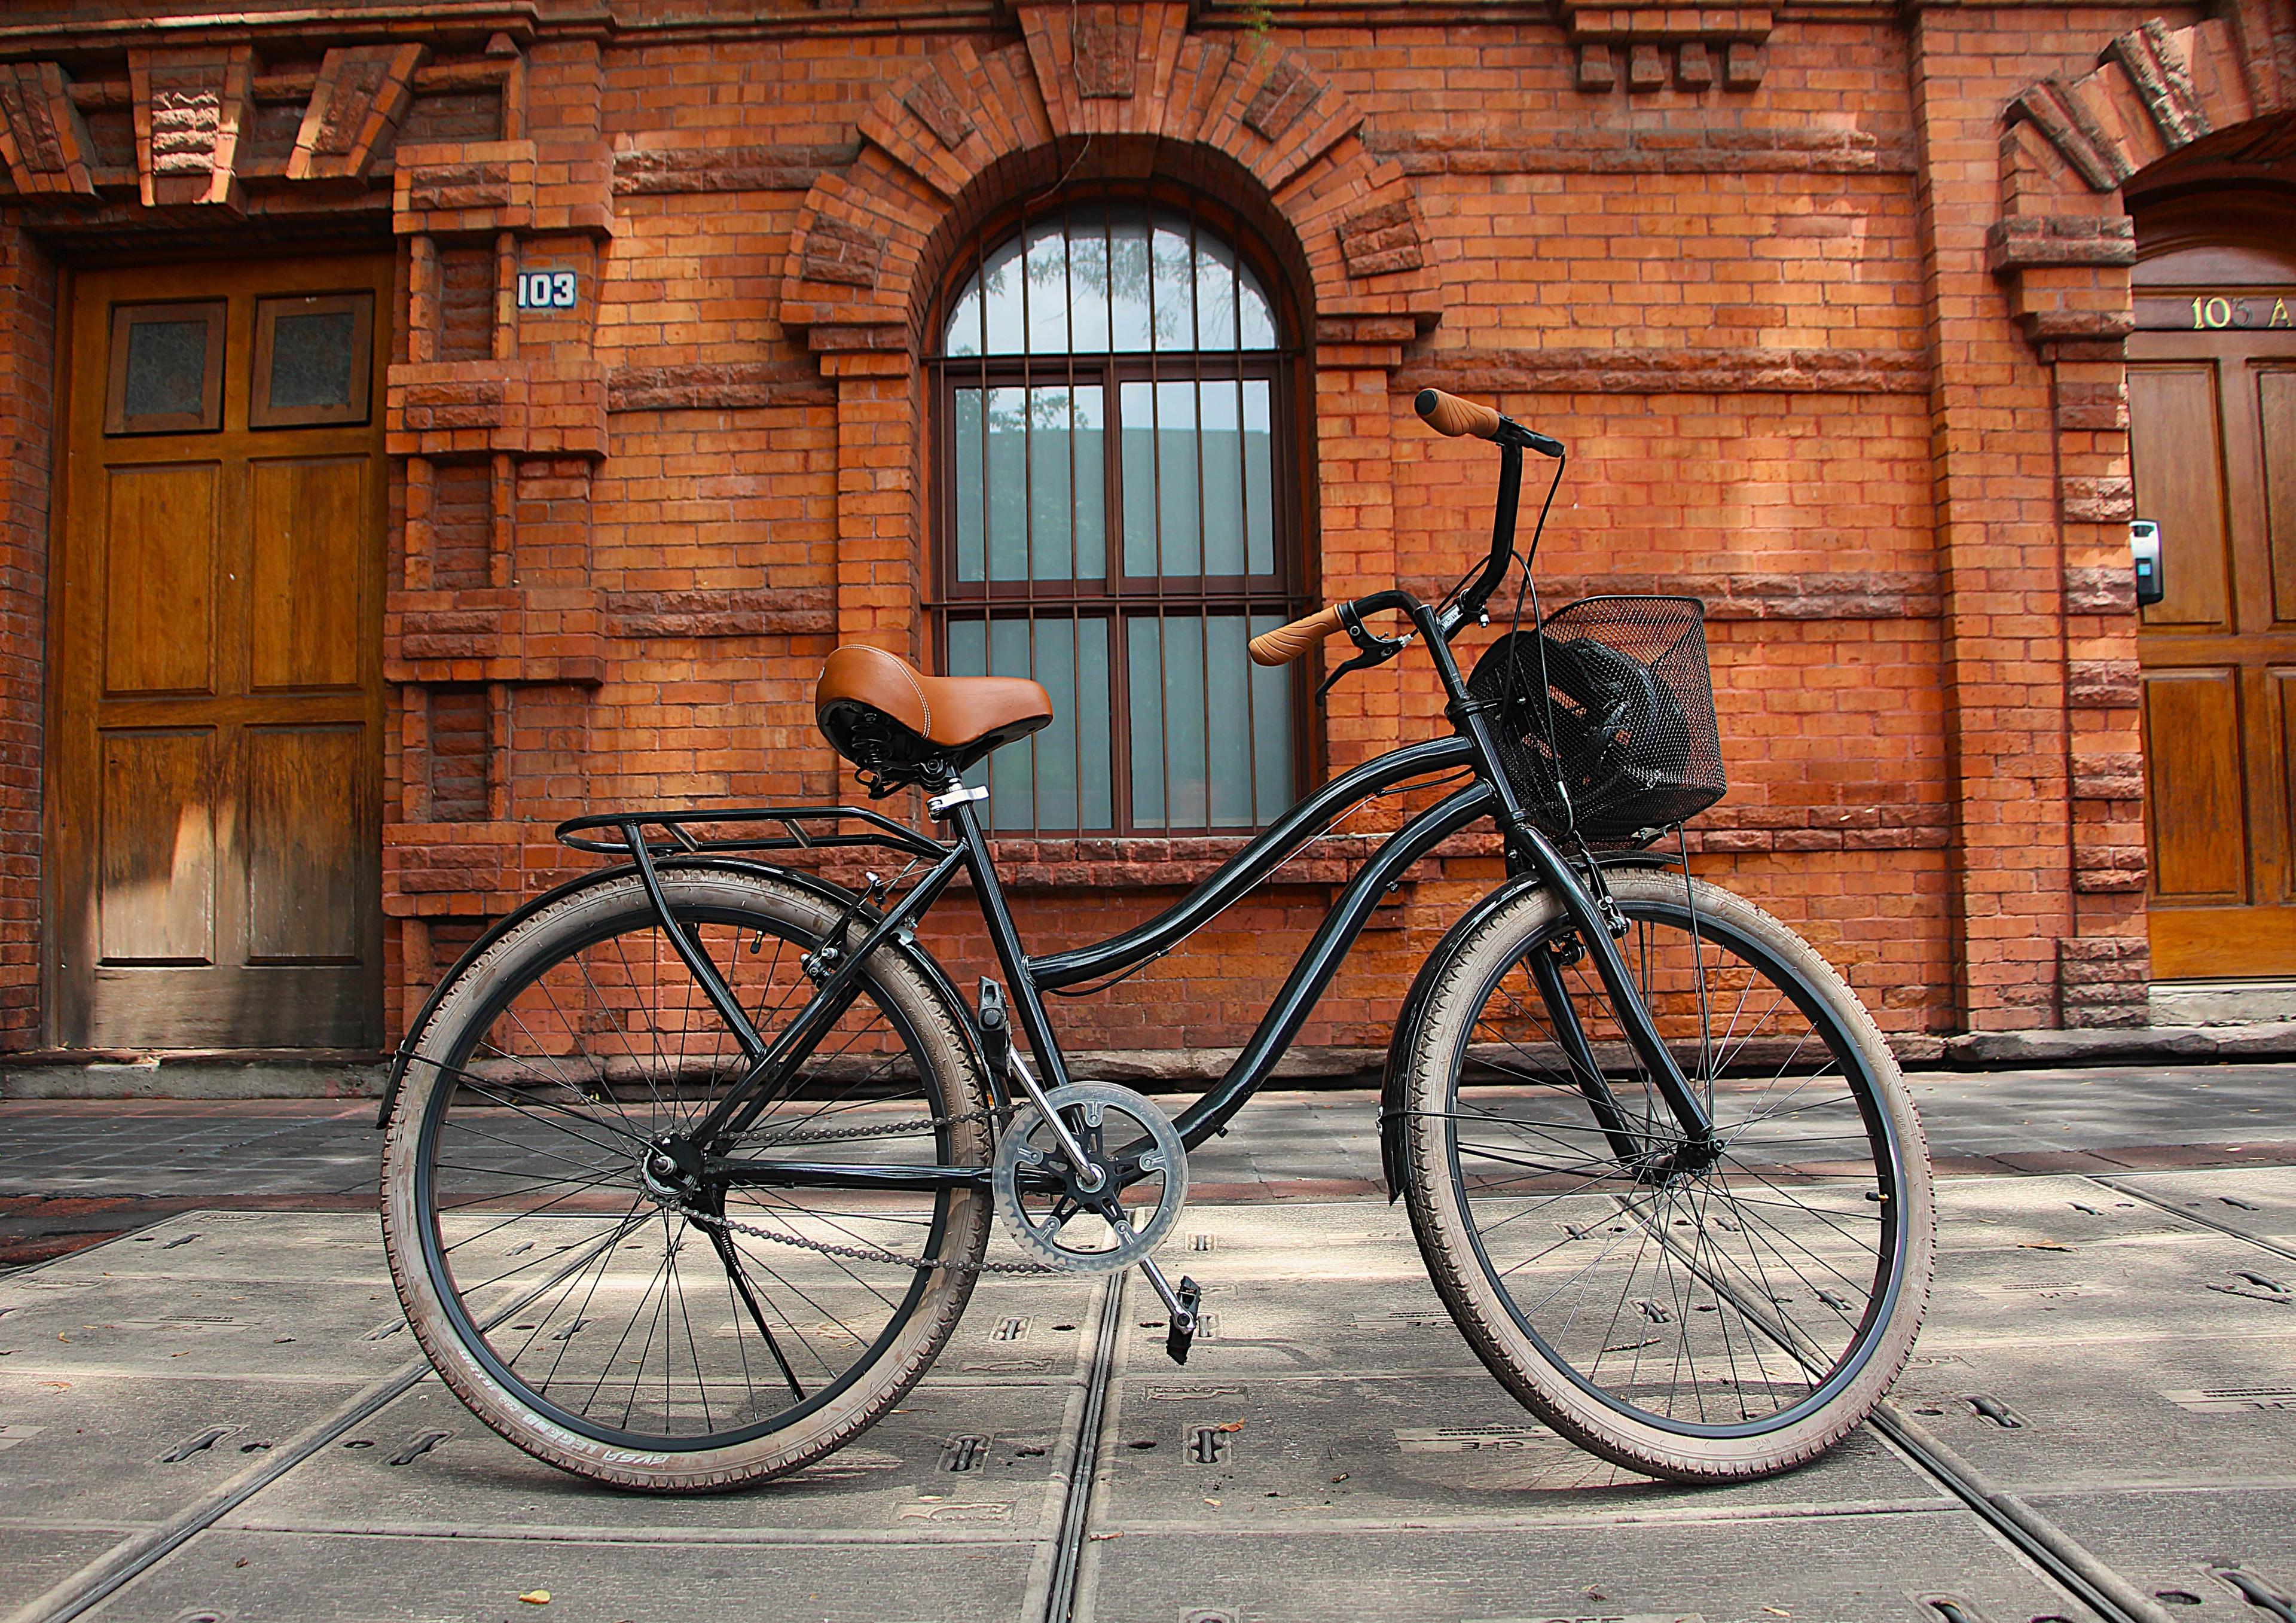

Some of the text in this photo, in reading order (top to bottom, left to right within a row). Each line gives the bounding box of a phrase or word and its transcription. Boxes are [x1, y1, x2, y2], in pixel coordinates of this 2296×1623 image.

[518, 273, 574, 306] 103
[2191, 297, 2294, 329] 105 A
[1461, 1441, 1523, 1450] CFE
